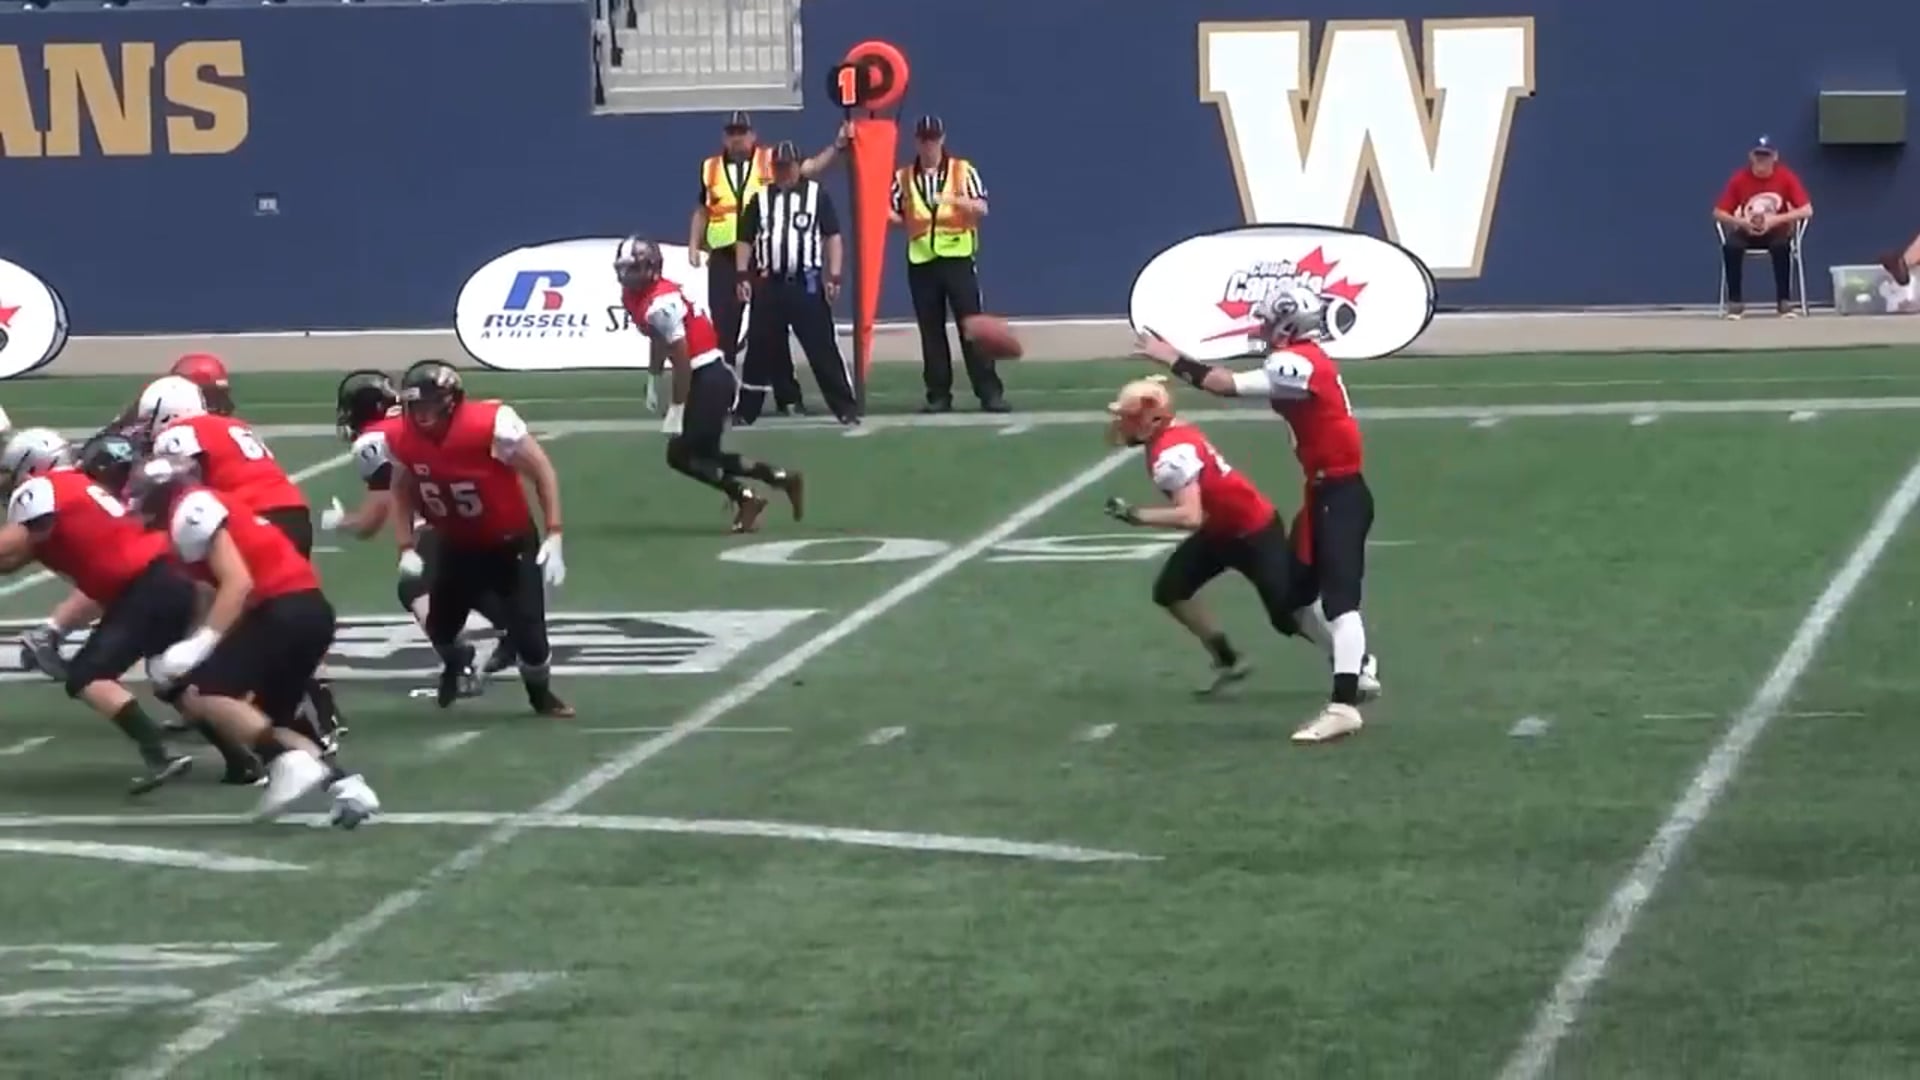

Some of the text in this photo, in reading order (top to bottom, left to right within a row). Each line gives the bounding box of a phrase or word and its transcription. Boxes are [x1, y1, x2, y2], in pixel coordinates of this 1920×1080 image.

[838, 66, 856, 105] 1
[1198, 16, 1535, 278] W
[483, 313, 590, 327] RUSSELL
[420, 482, 482, 517] 65
